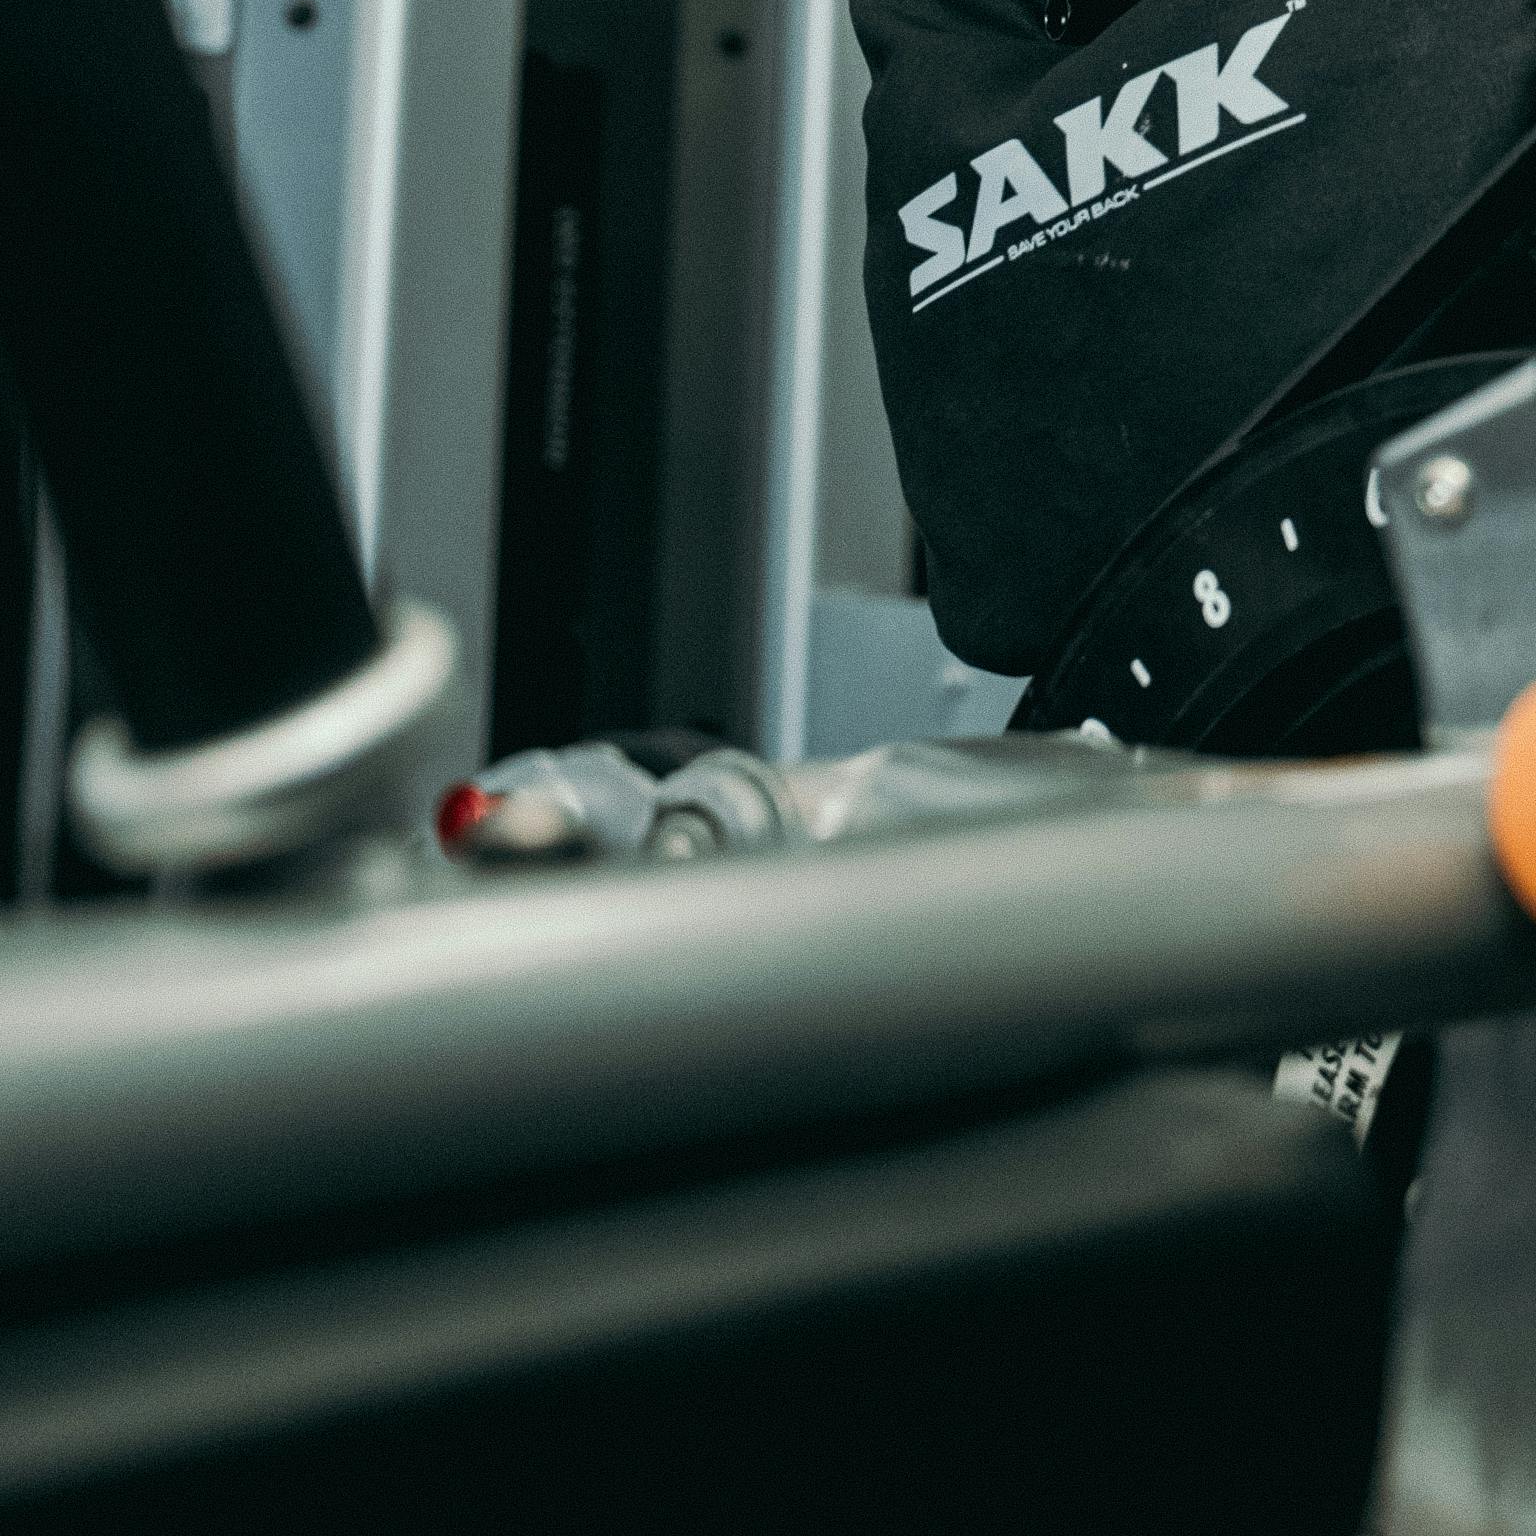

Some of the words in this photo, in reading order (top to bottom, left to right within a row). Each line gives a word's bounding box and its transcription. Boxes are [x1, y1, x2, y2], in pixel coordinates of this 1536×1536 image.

[898, 12, 1291, 297] SAKK
[1007, 230, 1047, 261] SAVE
[1045, 208, 1091, 240] YOUR
[1090, 184, 1140, 219] BACK
[1192, 569, 1231, 628] 8
